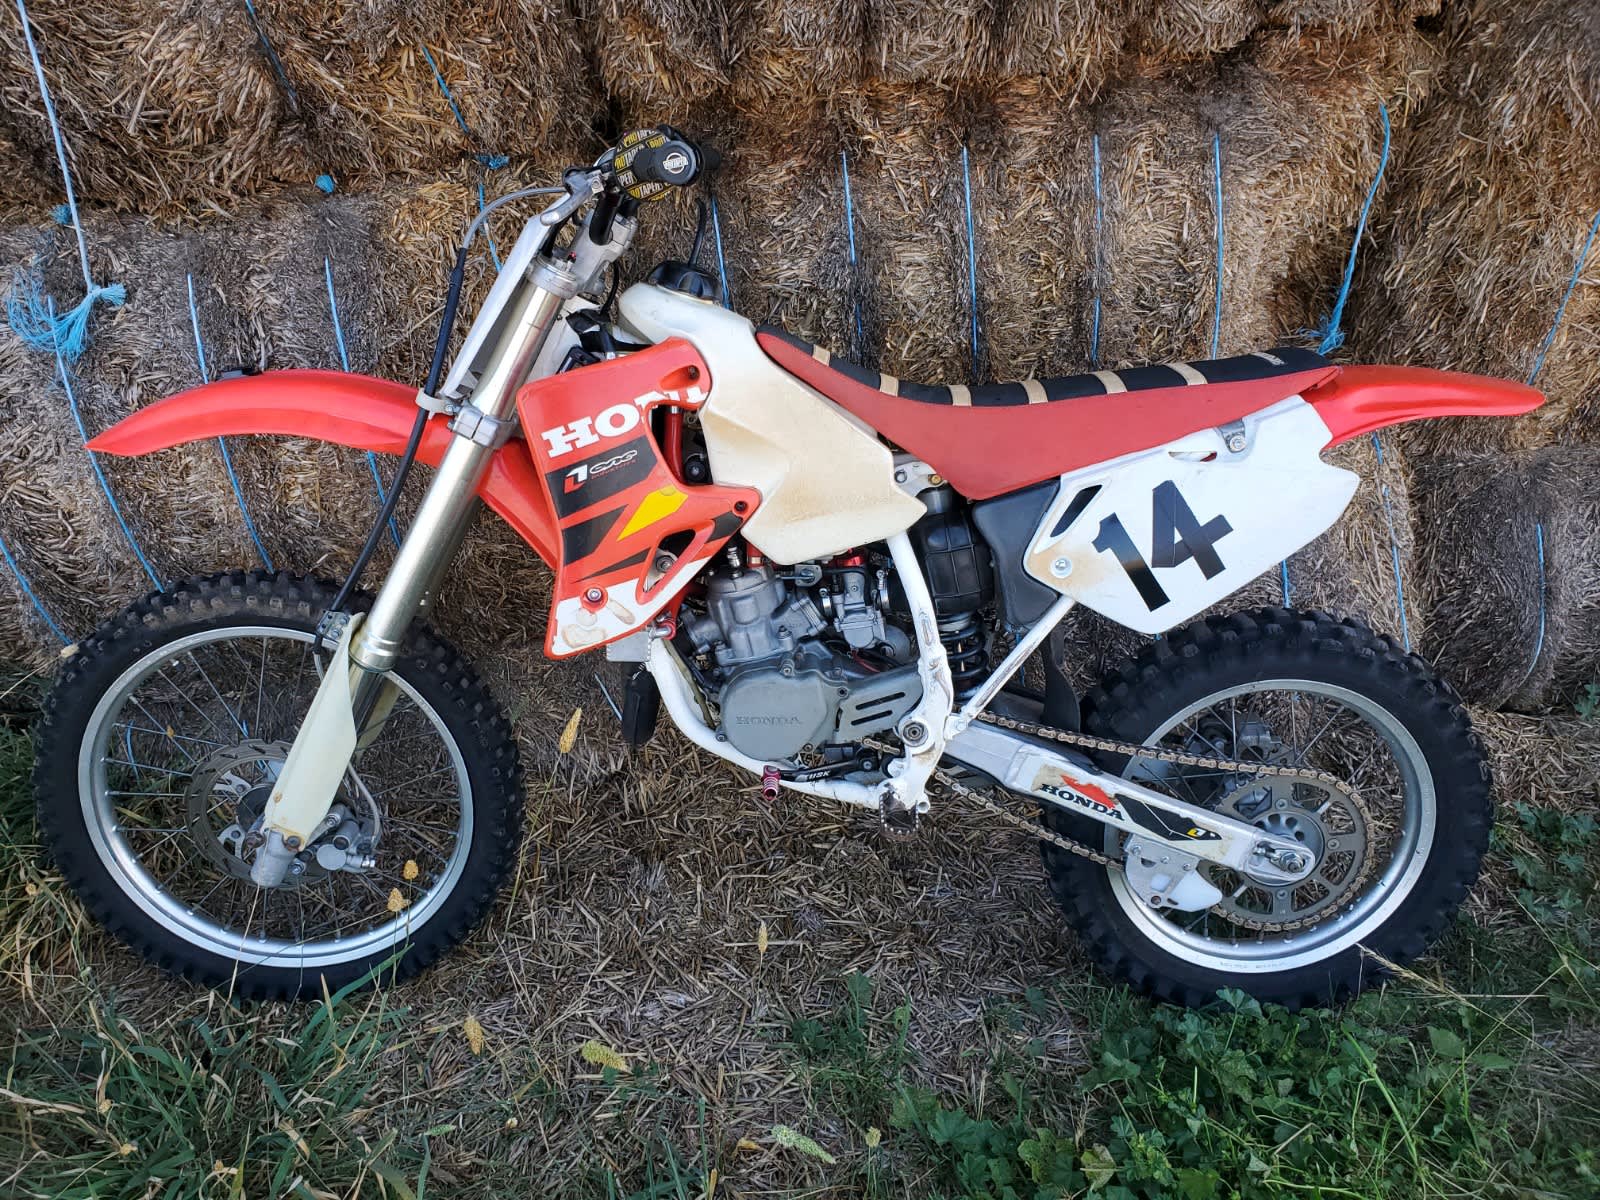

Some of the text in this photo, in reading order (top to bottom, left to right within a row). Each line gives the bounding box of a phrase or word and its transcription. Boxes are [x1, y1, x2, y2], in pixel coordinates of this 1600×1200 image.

[1091, 479, 1234, 613] 14
[736, 715, 803, 726] HONDA
[1039, 783, 1125, 821] HONDA
